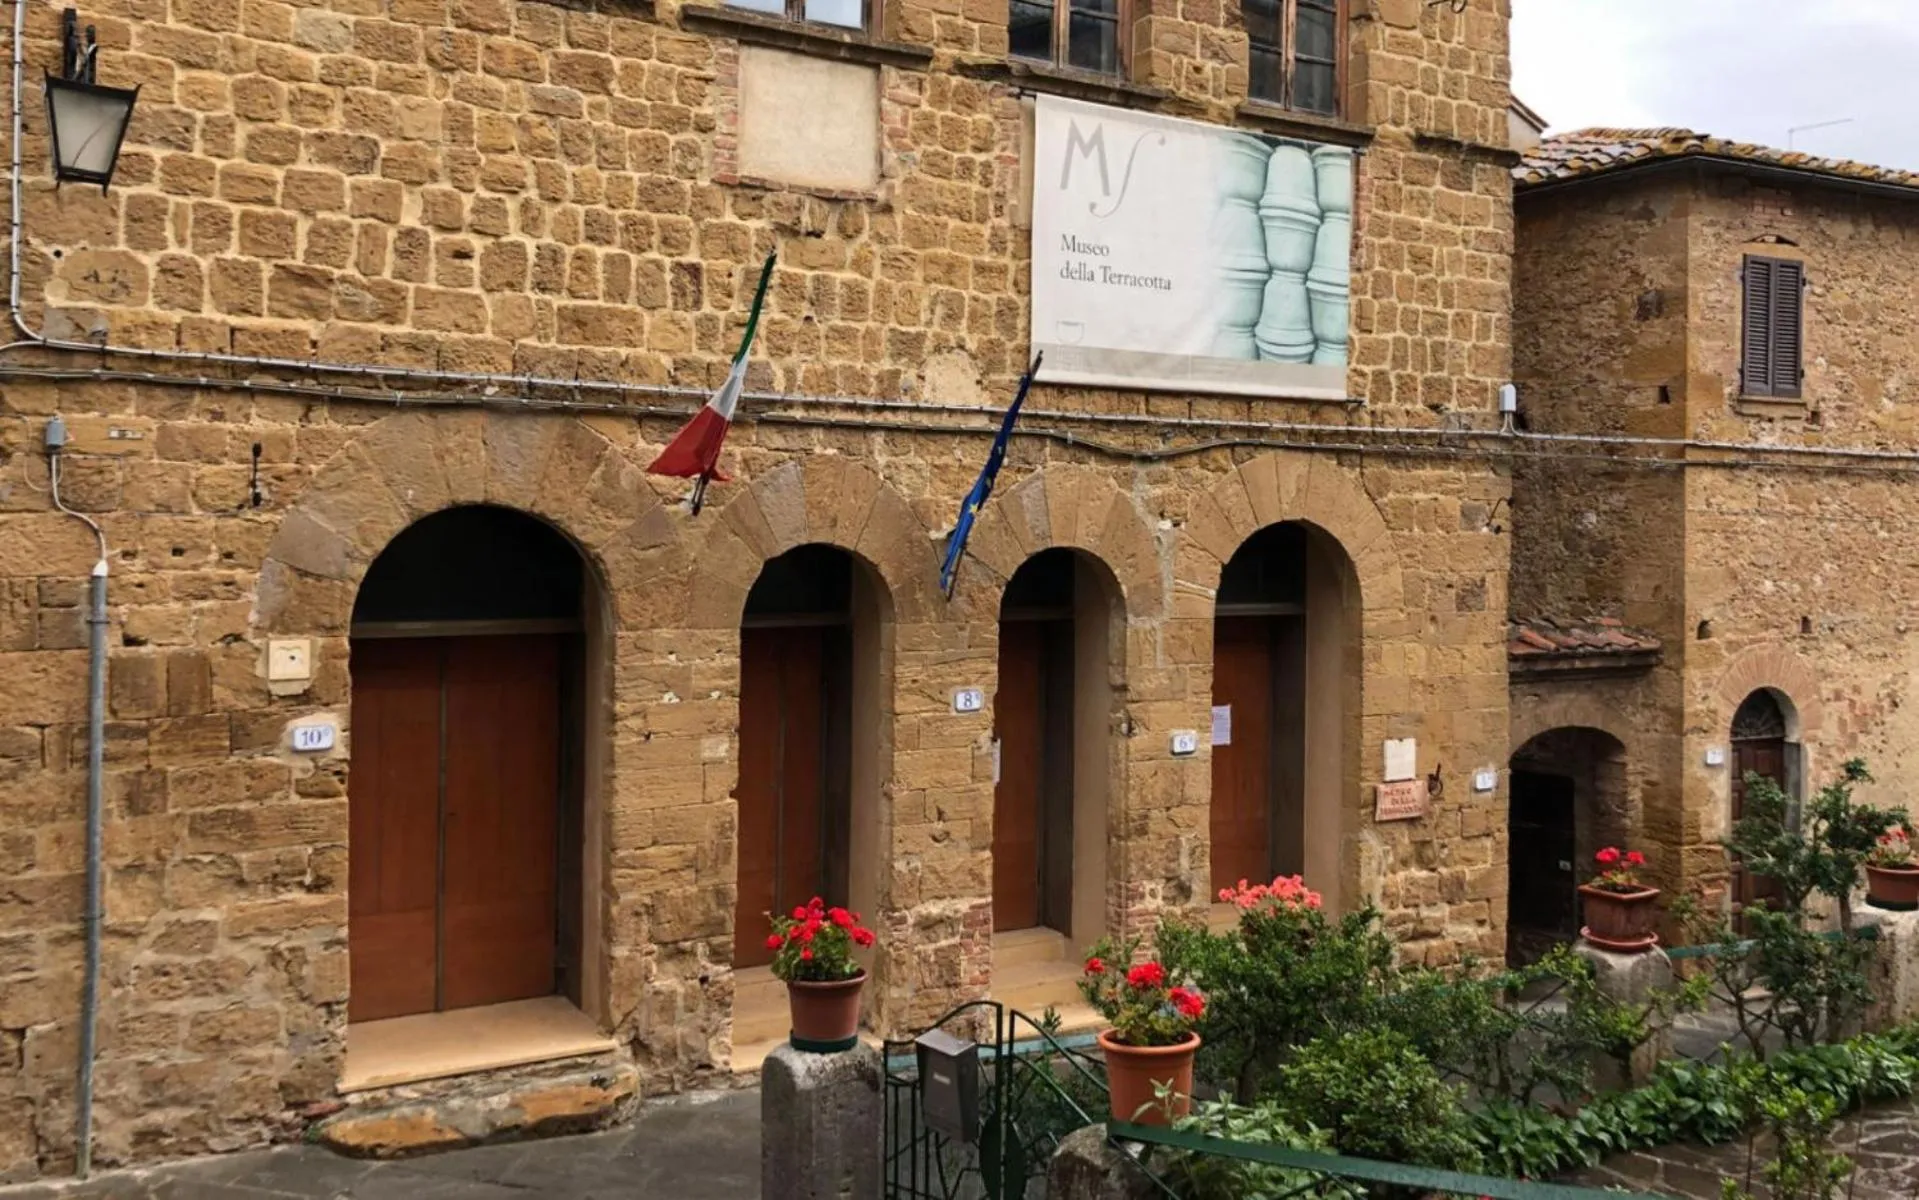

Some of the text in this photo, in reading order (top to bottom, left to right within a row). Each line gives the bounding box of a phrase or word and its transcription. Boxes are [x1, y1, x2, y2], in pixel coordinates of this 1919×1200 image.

[1061, 233, 1110, 256] Museo
[1060, 260, 1171, 291] della Terracotta
